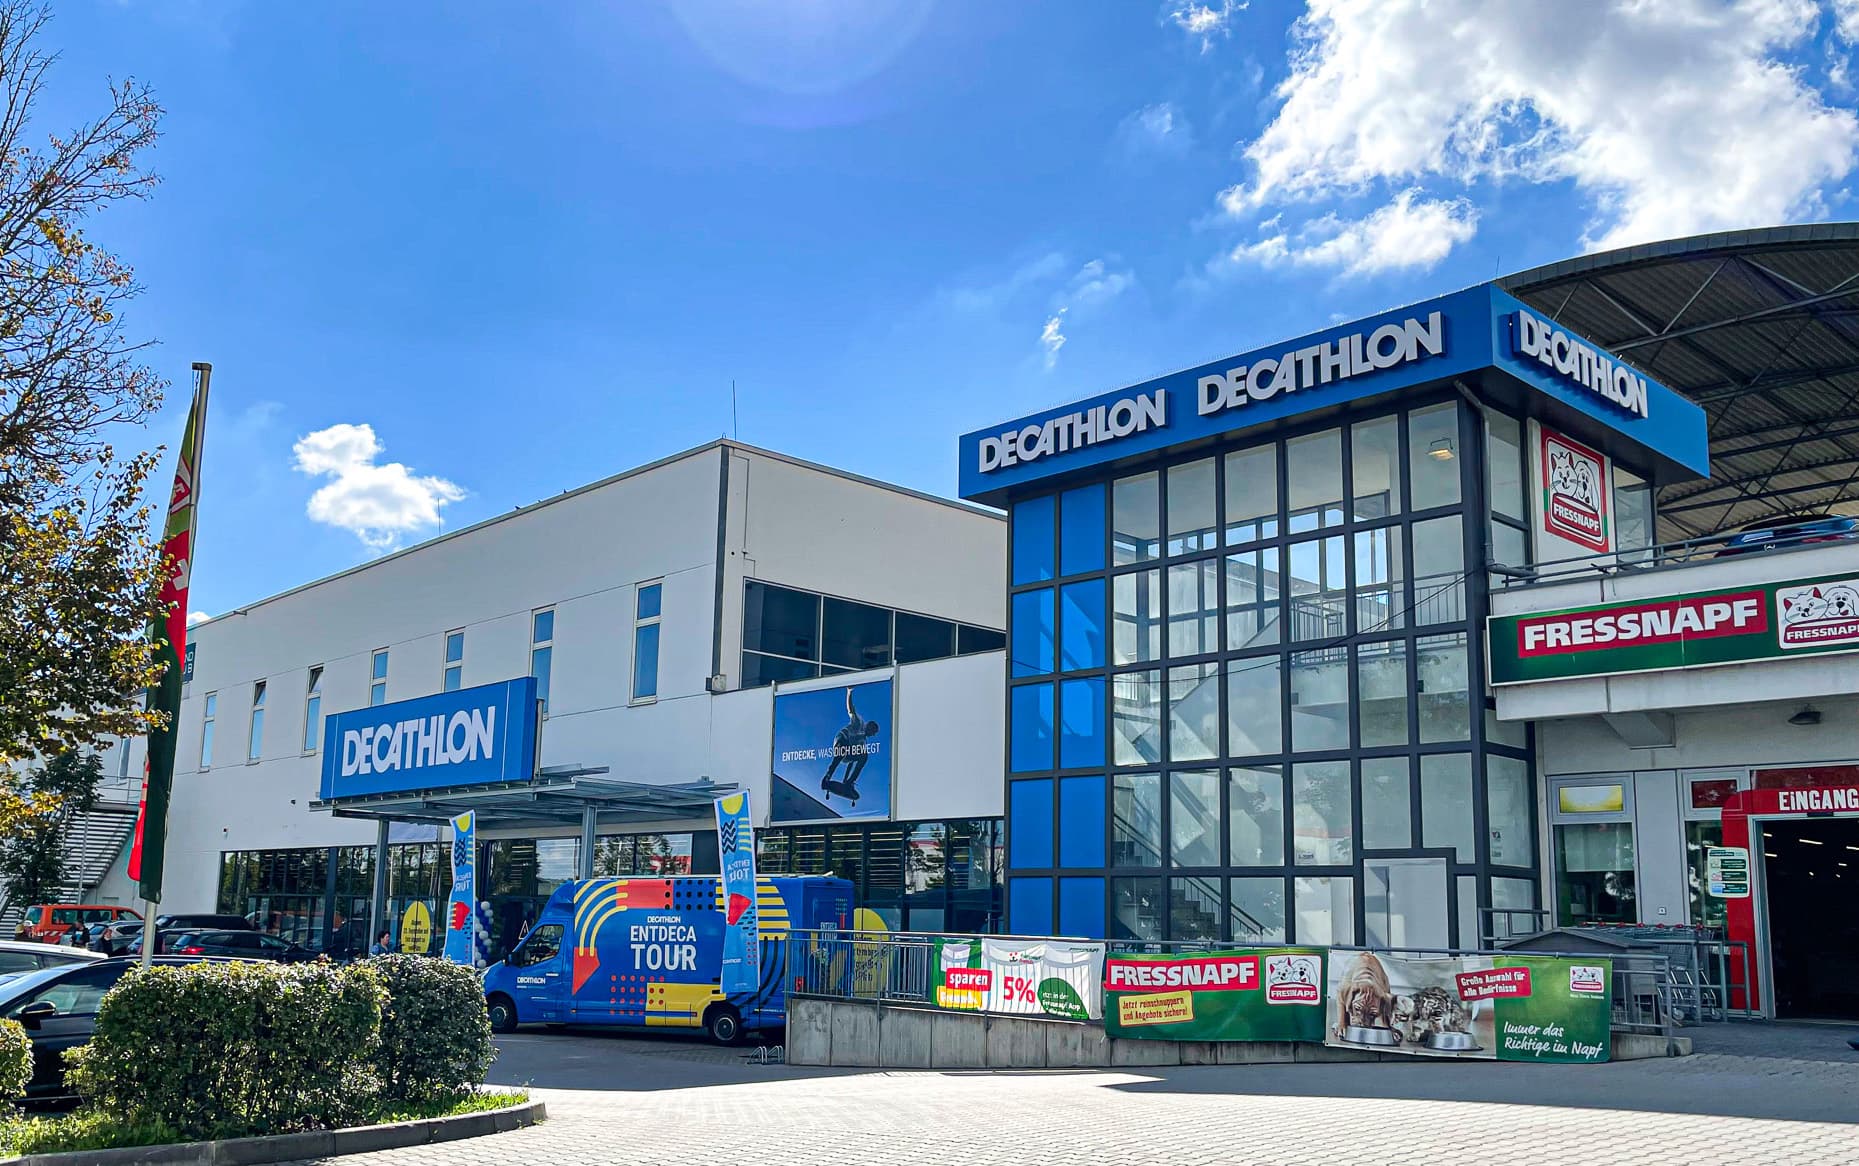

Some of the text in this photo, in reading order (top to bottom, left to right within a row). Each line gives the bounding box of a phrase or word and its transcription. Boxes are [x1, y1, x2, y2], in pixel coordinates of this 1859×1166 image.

[1198, 311, 1443, 415] DECATHLON
[1519, 309, 1648, 419] DECATHLON
[979, 388, 1166, 473] DECATHLON
[1553, 502, 1599, 532] FRESSNAPF
[1524, 599, 1757, 650] FRESSNAPF
[1786, 624, 1859, 640] FRESSNAP
[341, 705, 496, 777] DECATHLON
[782, 742, 880, 762] ENTDECKE, WAS DICH BEWEGT
[630, 925, 697, 942] ENTDECA
[630, 944, 697, 971] TOUR
[949, 973, 988, 988] sparen
[1110, 962, 1255, 987] FRESSNAPF
[1004, 976, 1036, 1003] 5%
[1504, 1021, 1564, 1037] Immer das
[1504, 1036, 1604, 1060] Richtige im Napf
